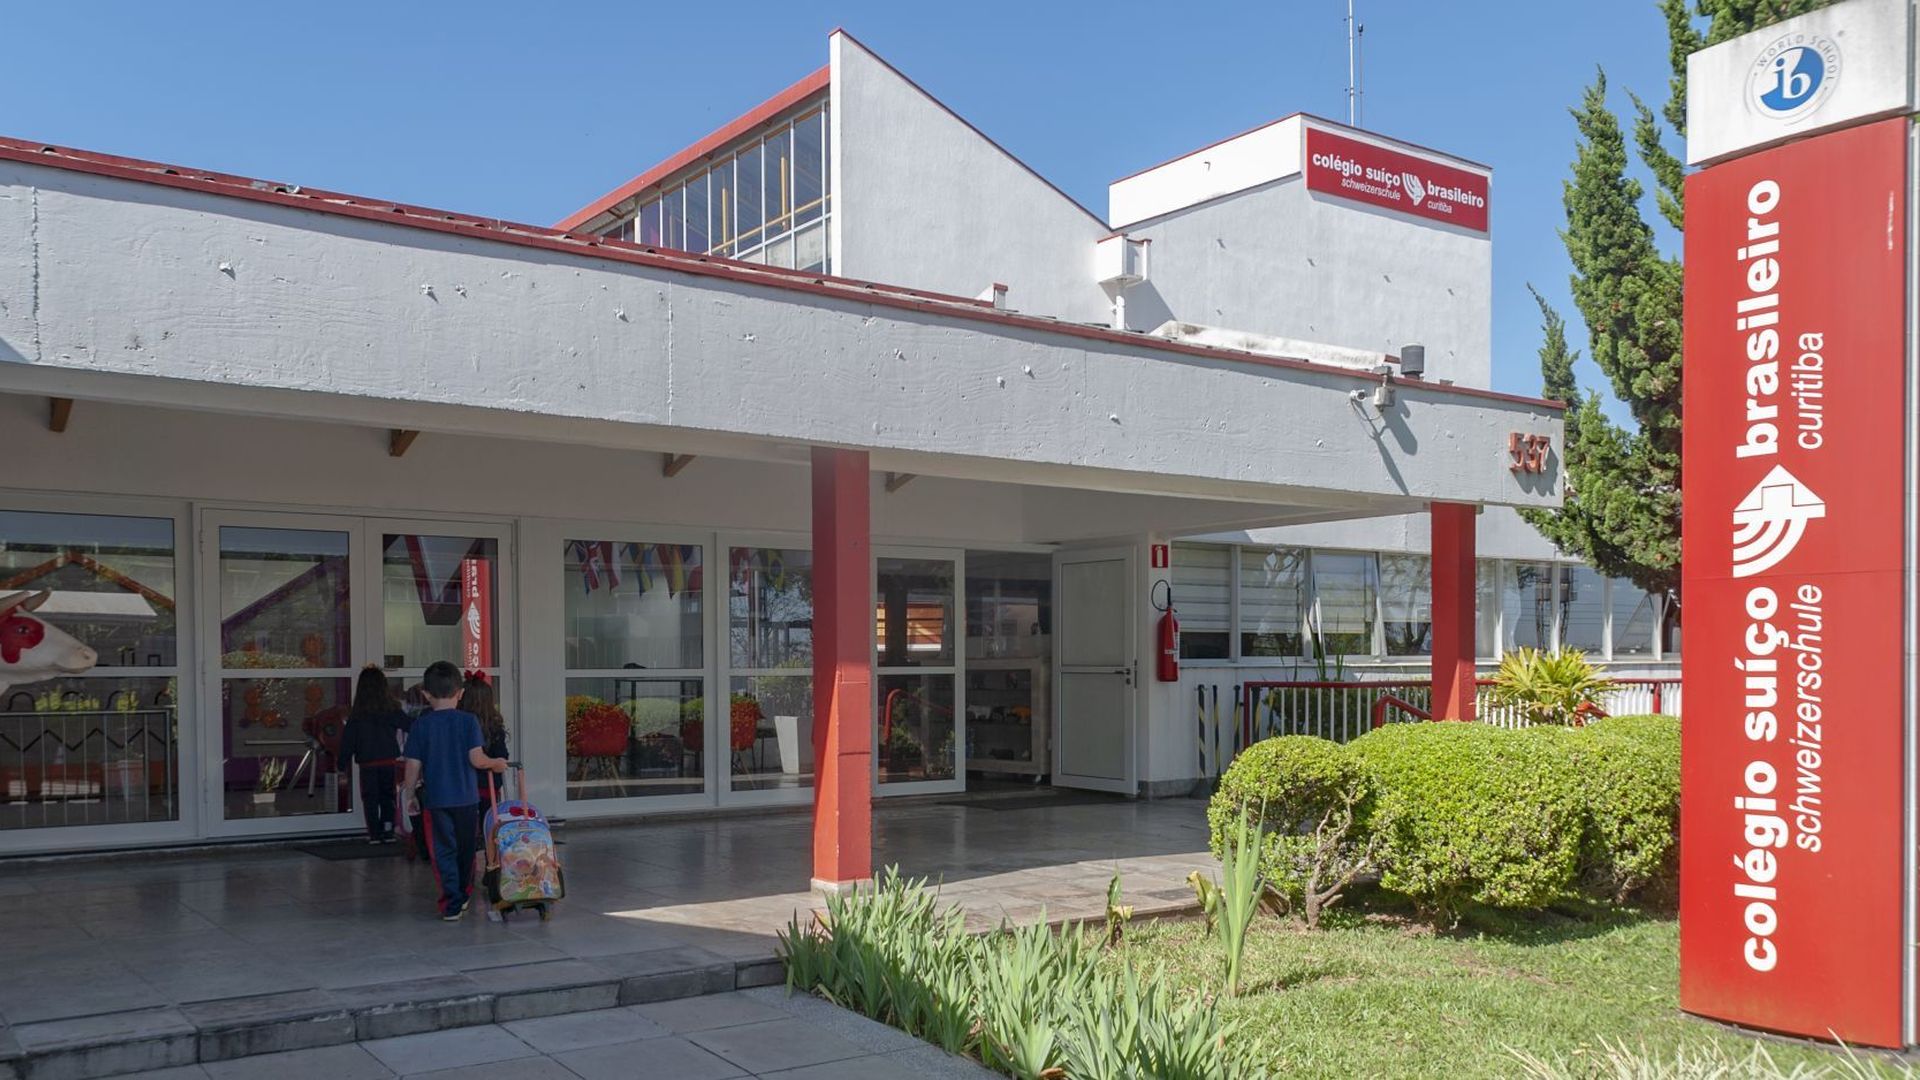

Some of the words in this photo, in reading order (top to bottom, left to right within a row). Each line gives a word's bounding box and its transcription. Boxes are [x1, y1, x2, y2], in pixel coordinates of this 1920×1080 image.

[1757, 34, 1804, 67] WORLD
[1809, 35, 1838, 80] SCHOOL
[1773, 57, 1812, 99] ib
[1312, 153, 1362, 177] colégio
[1365, 167, 1401, 188] suíço
[1427, 180, 1484, 208] brasileiro
[1340, 177, 1401, 201] schweizerschule
[1427, 200, 1453, 214] curitiba
[1736, 179, 1781, 458] brasileiro
[1790, 331, 1824, 450] curitiba
[1509, 431, 1551, 473] 537
[1734, 586, 1789, 743] suíço
[1789, 583, 1822, 853] schweizerschule
[1734, 760, 1788, 972] colégio
